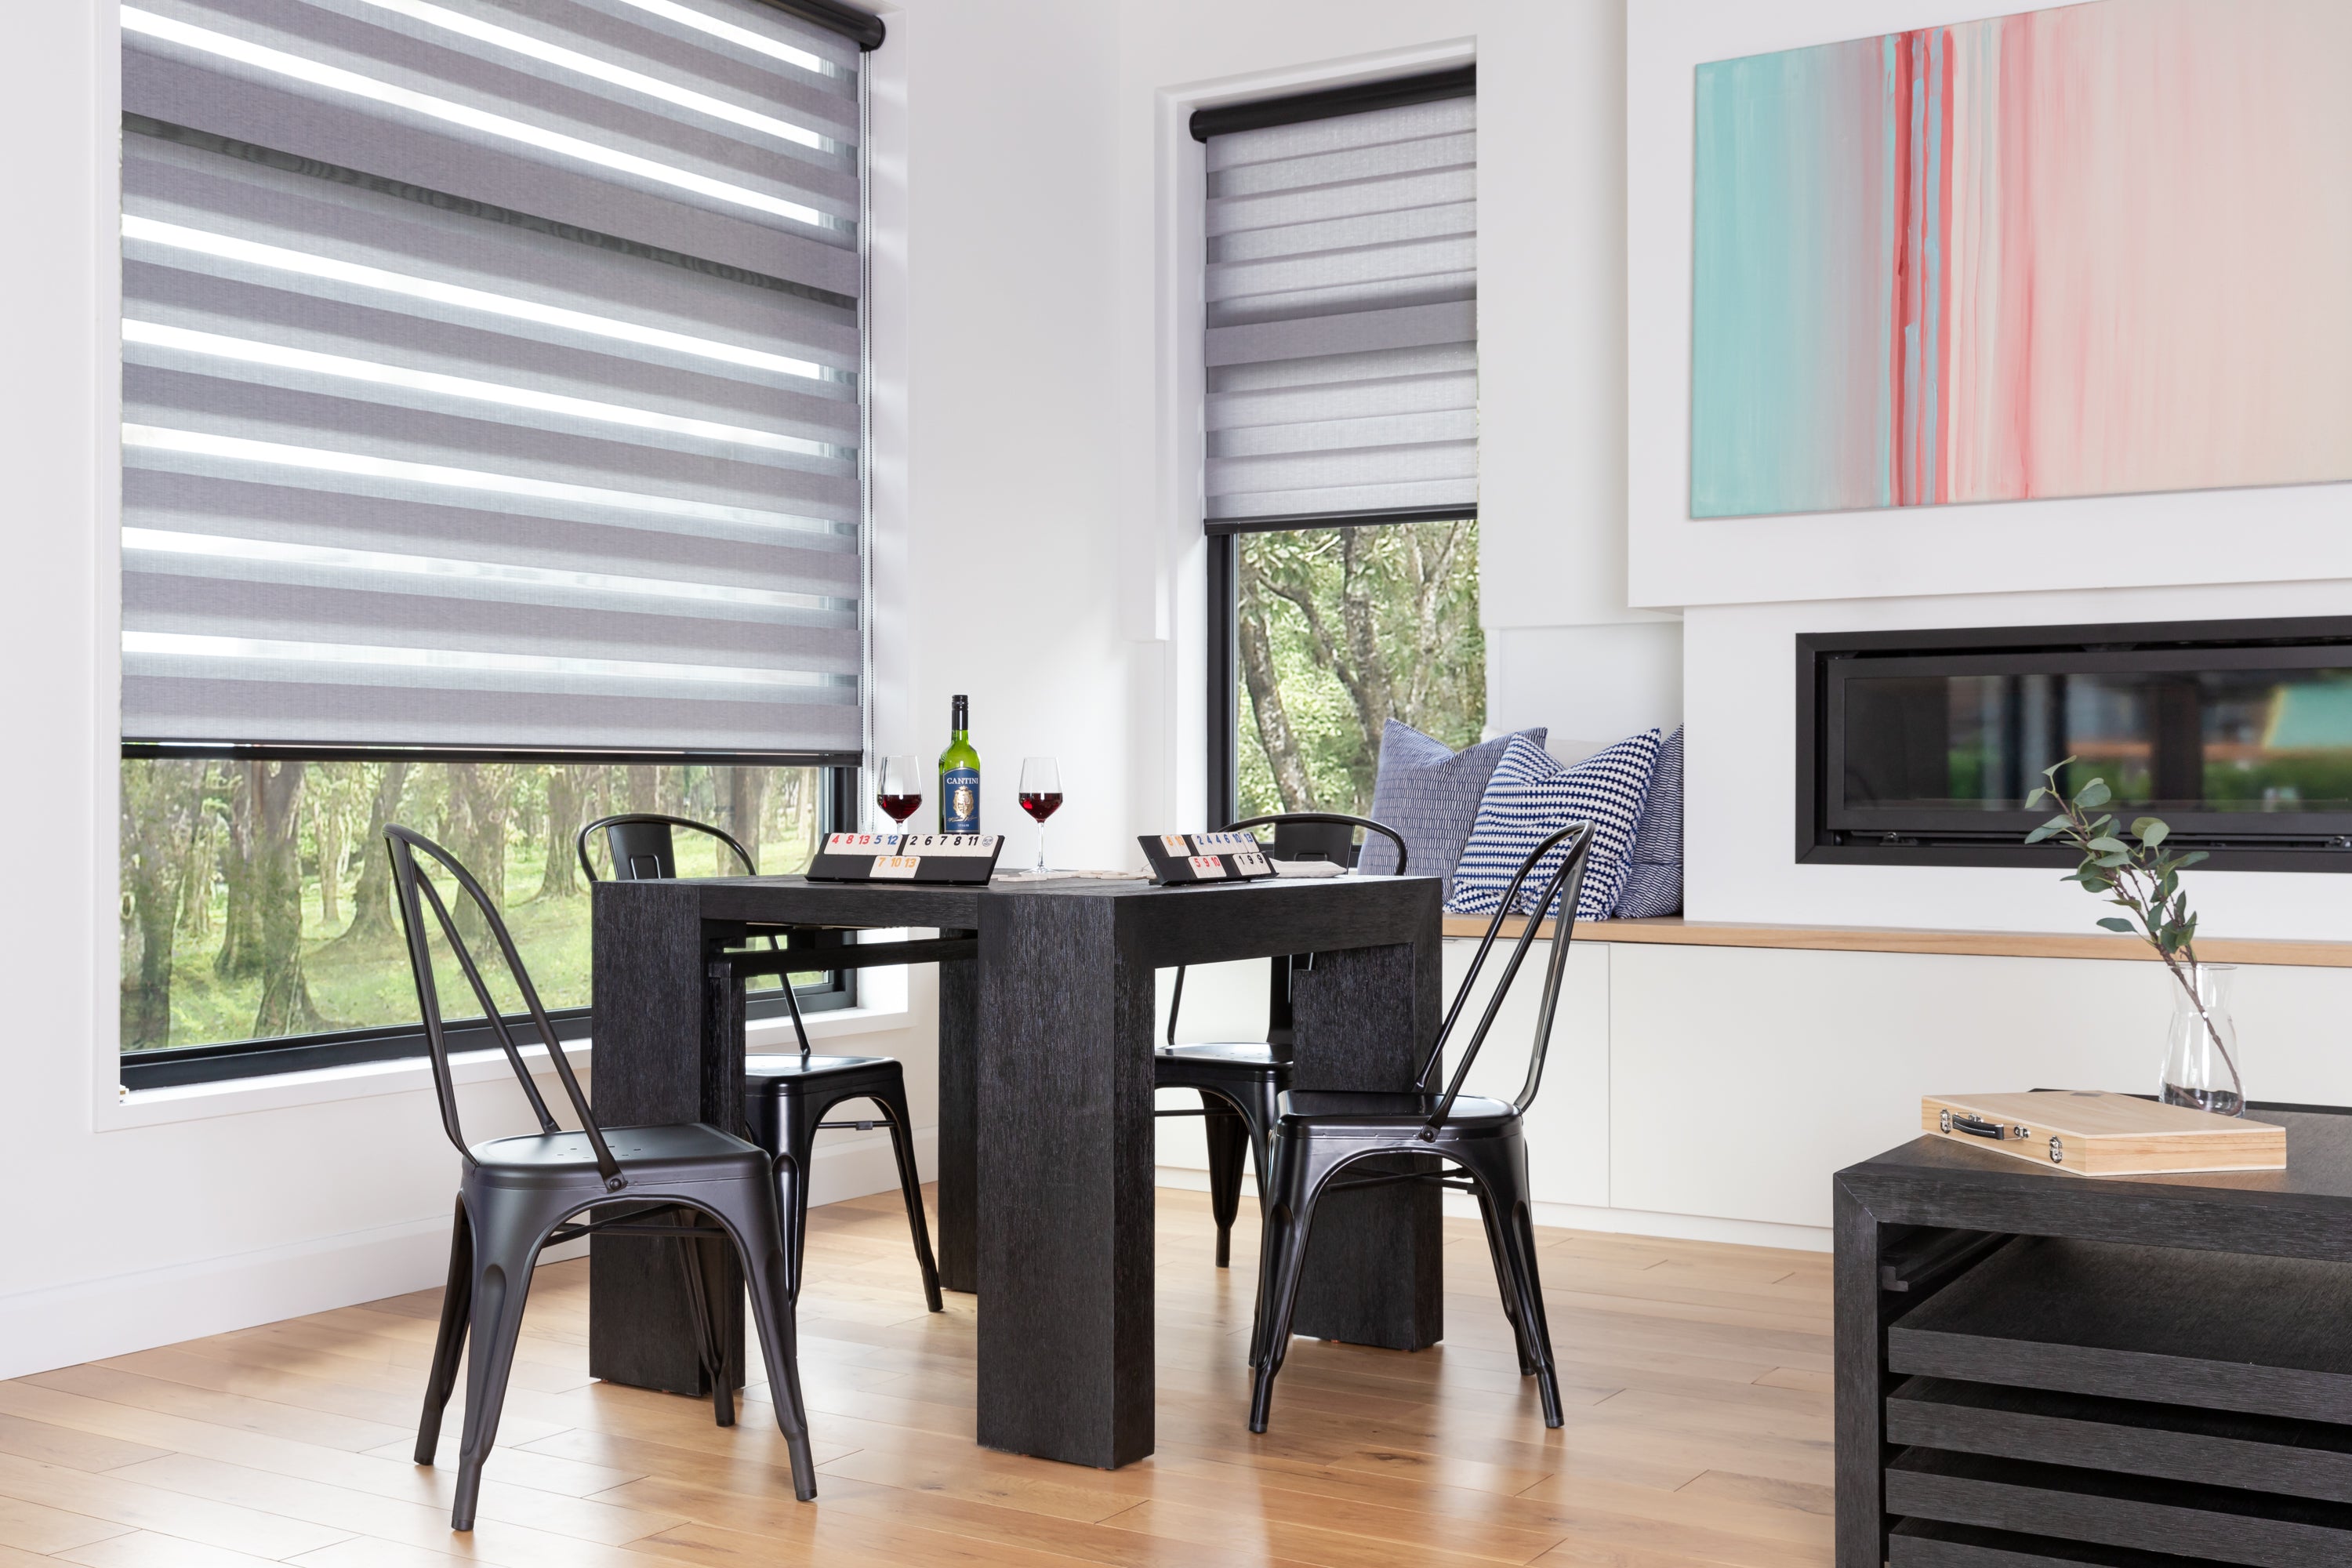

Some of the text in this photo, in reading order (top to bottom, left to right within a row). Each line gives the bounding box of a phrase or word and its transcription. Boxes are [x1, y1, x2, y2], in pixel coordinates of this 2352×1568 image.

[832, 835, 898, 844] 4 8 13 5 12
[910, 836, 978, 845] 2 6 7 8 11
[1174, 836, 1185, 846] 10
[1197, 833, 1253, 844] 2 4 4 6 10 13
[878, 858, 916, 867] 7 10 13
[1194, 857, 1221, 867] 5 9 10
[1239, 854, 1264, 865] 1 9 9
